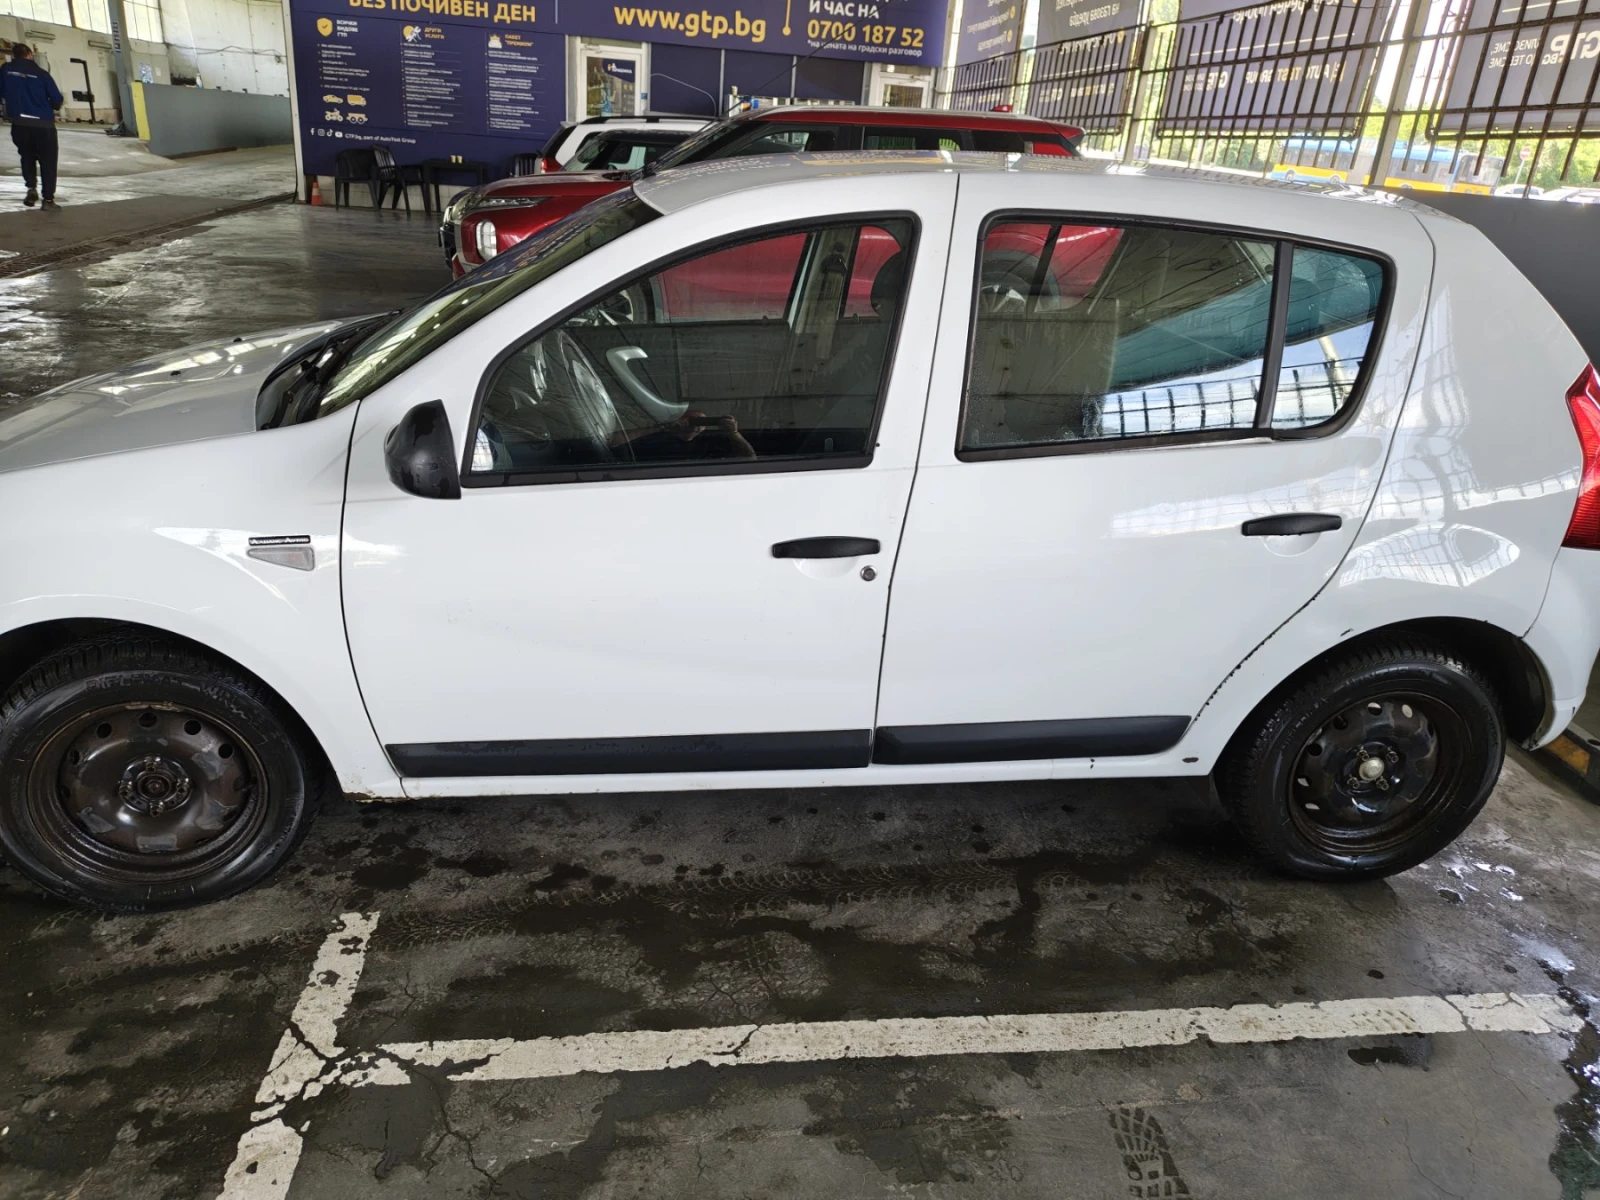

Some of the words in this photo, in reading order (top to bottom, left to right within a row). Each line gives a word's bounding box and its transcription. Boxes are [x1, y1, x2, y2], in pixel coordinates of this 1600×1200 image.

[391, 0, 489, 18] ПОЧИВЕН
[493, 3, 536, 24] ДЕН
[808, 0, 821, 14] И
[823, 1, 855, 17] ЧАС
[857, 4, 880, 19] НА
[613, 6, 766, 43] www.gtp.bg
[807, 19, 857, 42] 0700
[862, 24, 897, 45] 187
[900, 27, 925, 48] 52
[847, 44, 858, 52] на
[858, 45, 888, 55] градски
[888, 47, 923, 57] разговор
